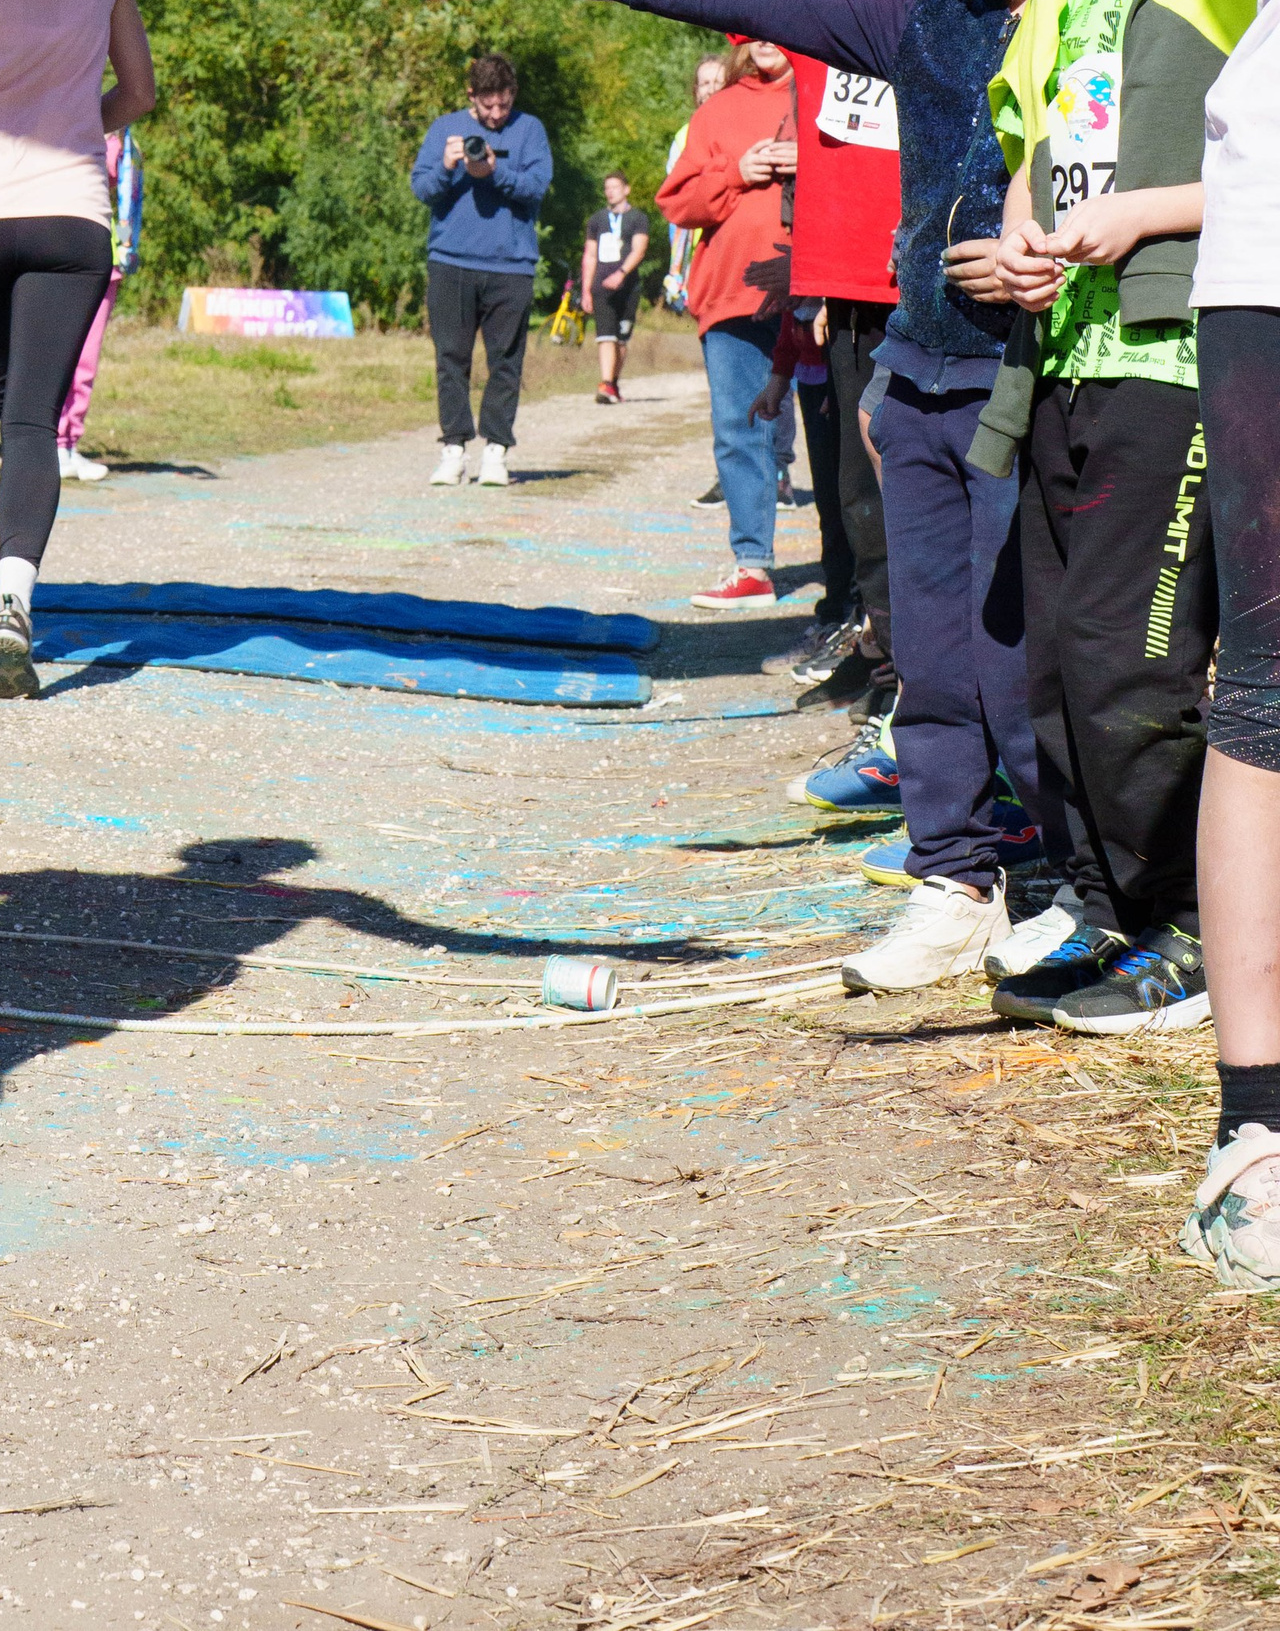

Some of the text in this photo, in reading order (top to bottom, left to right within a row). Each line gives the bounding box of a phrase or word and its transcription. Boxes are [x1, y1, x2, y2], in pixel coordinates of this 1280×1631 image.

[833, 71, 890, 107] 327
[1051, 161, 1117, 211] 297
[1083, 290, 1095, 320] PRO
[1118, 352, 1150, 363] FILA
[1164, 474, 1202, 562] LIMIT
